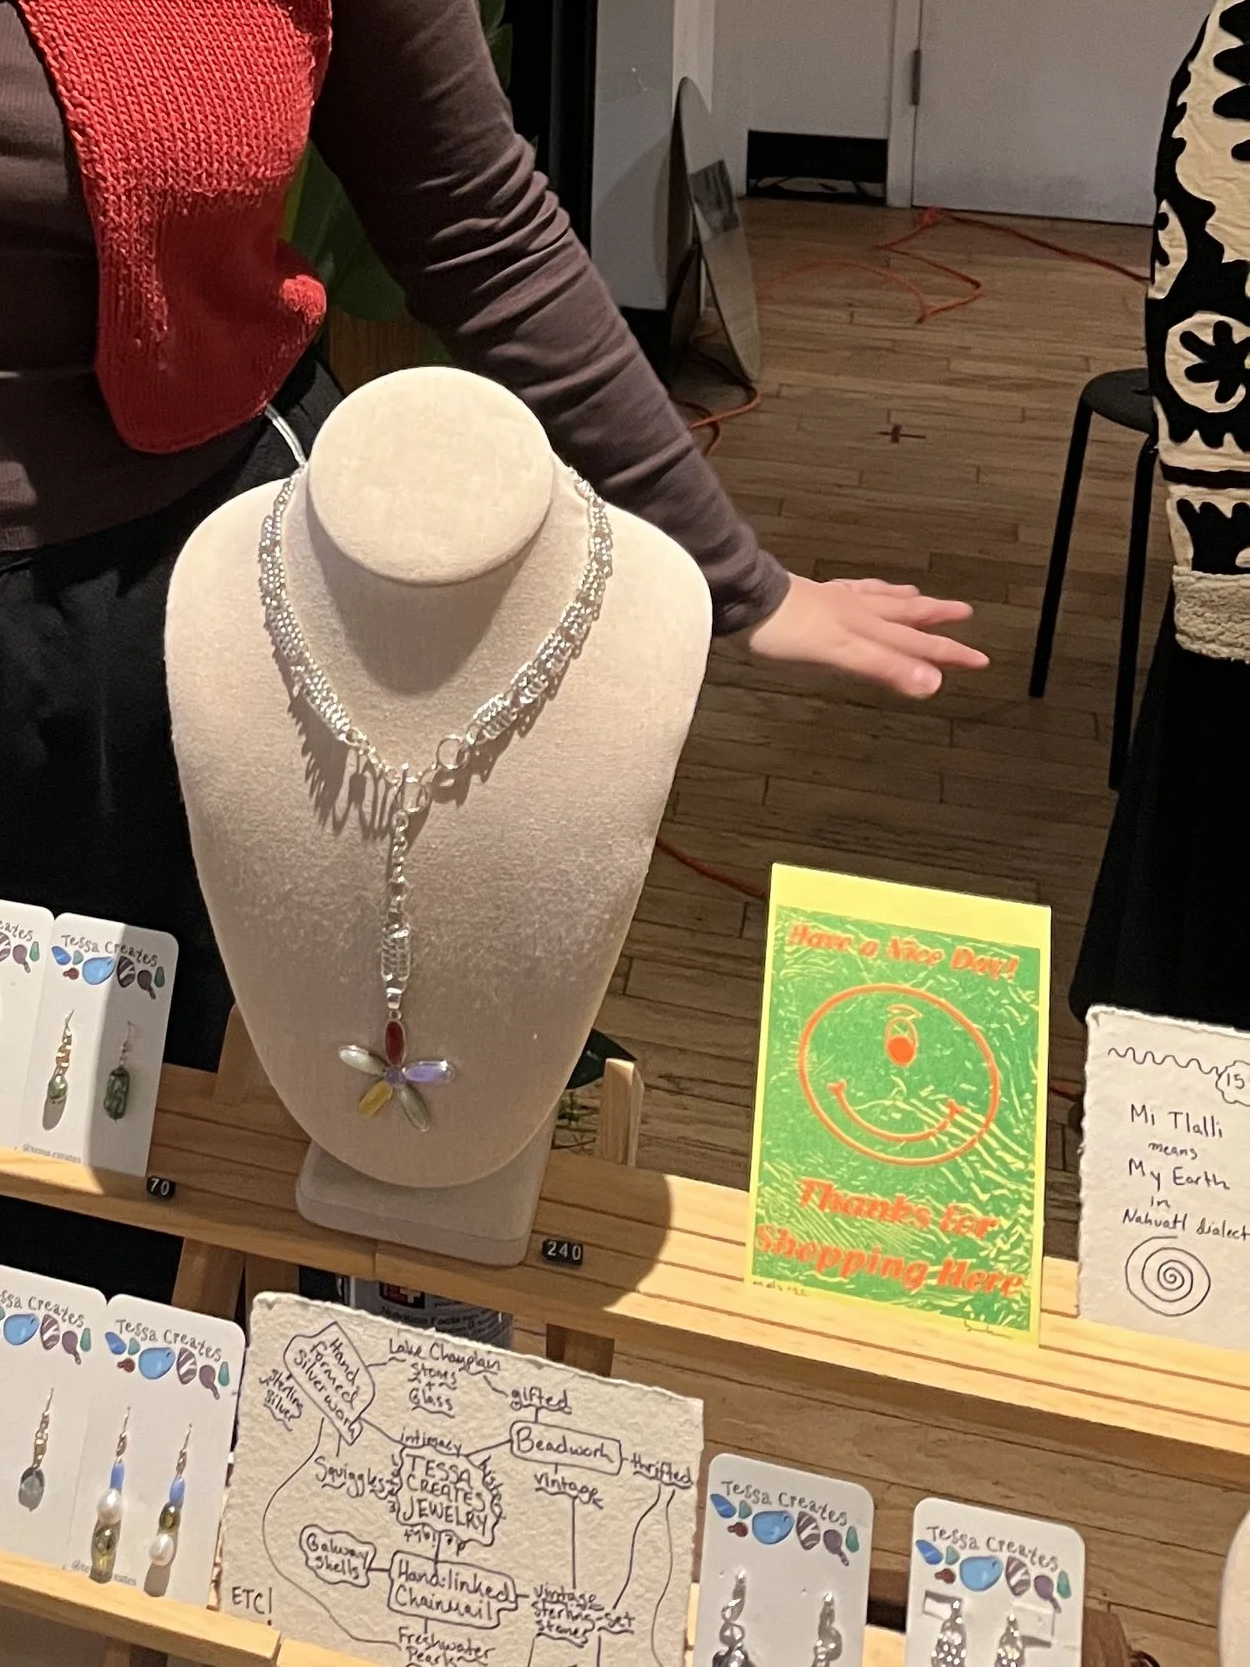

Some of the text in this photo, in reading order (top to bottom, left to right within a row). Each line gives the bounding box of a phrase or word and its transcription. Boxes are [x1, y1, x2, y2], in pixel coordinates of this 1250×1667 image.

[61, 934, 158, 967] Tessa Creates
[787, 922, 1019, 981] Have a Nice Day!
[1148, 1142, 1198, 1160] means
[150, 1177, 170, 1197] 70
[1129, 1158, 1230, 1190] My Earth
[798, 1177, 1000, 1241] Thanks for
[547, 1241, 582, 1261] 240
[754, 1223, 1023, 1298] Shopping Here
[28, 1295, 85, 1328] Creates
[115, 1319, 222, 1362] Tessa Creates
[390, 1338, 427, 1359] Lake
[329, 1337, 359, 1385] Hand
[510, 1386, 568, 1411] gifted
[516, 1426, 614, 1463] Beadwork
[406, 1454, 473, 1489] TESSA
[631, 1453, 694, 1485] thrifted
[407, 1474, 485, 1512] CREATES
[721, 1479, 847, 1528] Tessa Creates
[403, 1496, 487, 1536] JEWELRY
[927, 1525, 1059, 1573] Tessa Creates
[231, 1588, 274, 1626] ETC!
